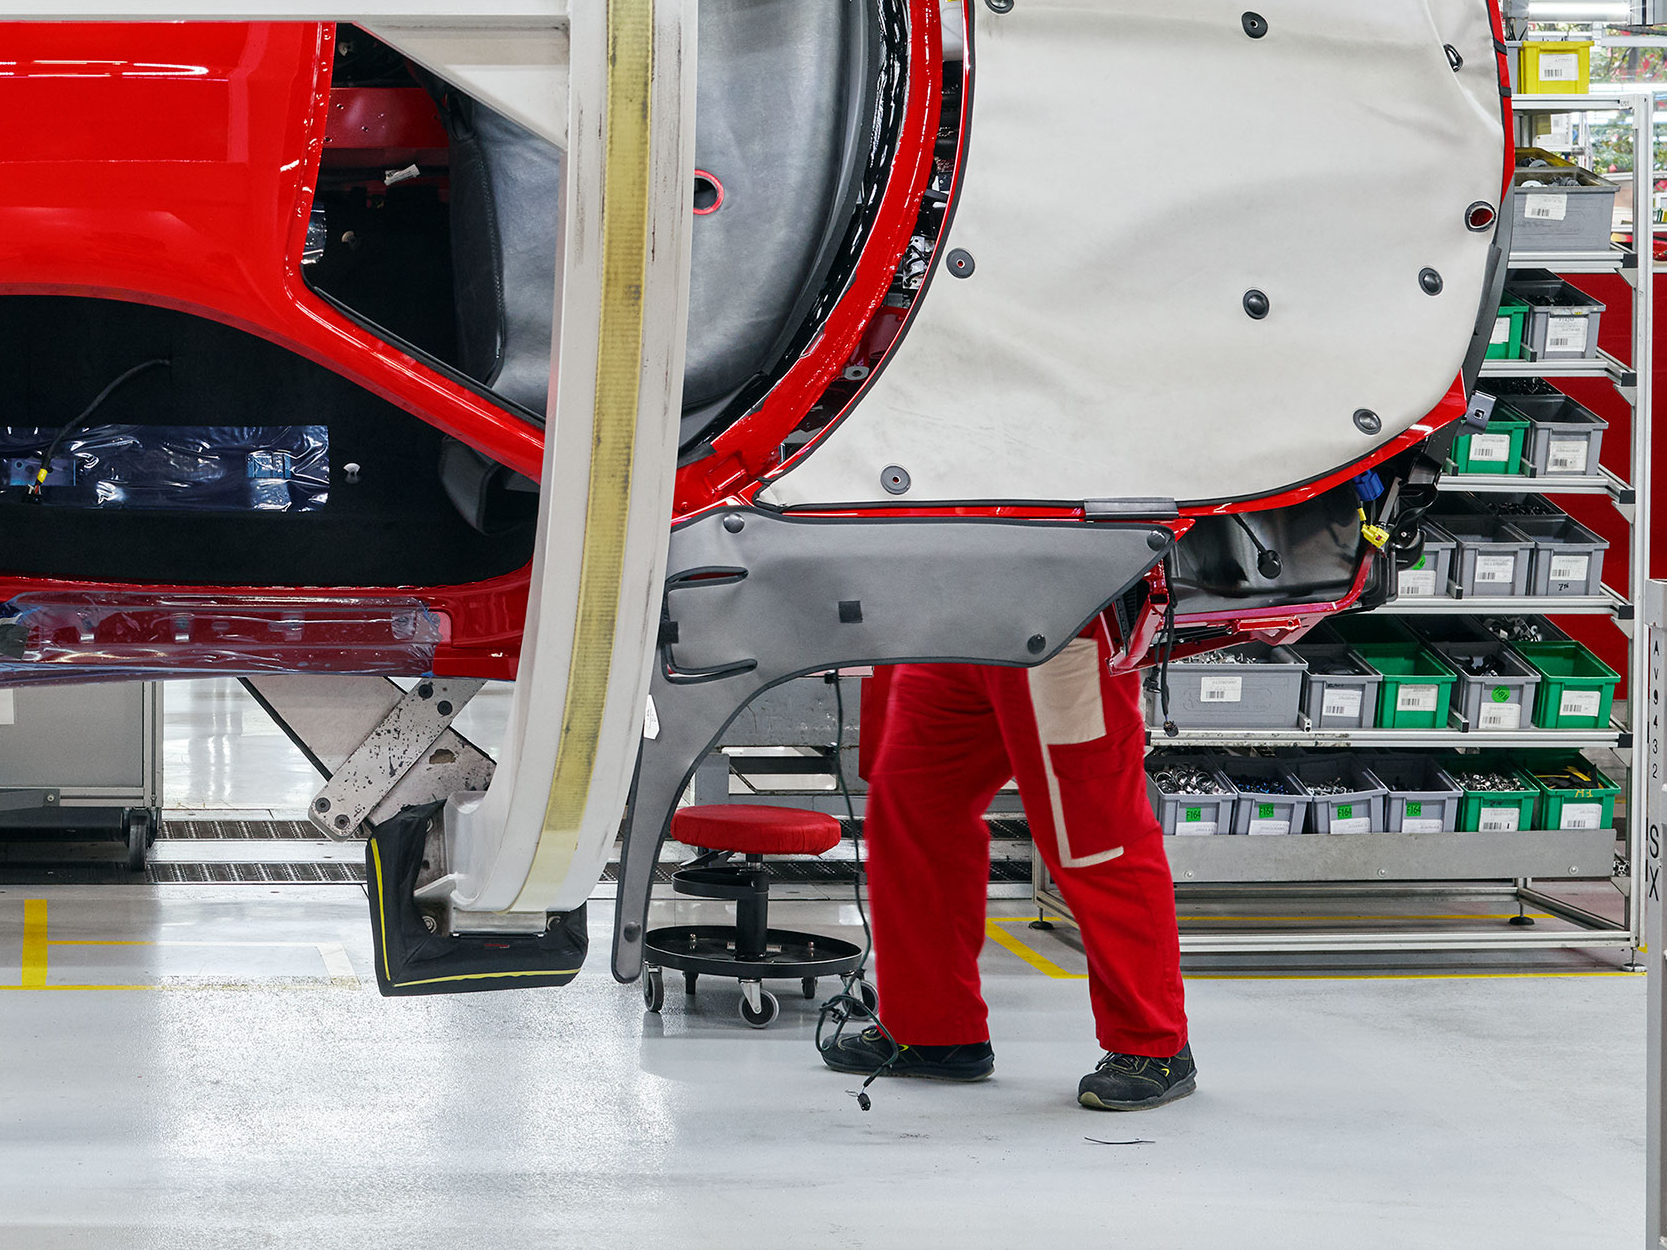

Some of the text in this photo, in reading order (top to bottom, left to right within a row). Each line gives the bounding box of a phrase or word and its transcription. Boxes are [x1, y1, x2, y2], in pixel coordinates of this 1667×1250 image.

[1259, 807, 1274, 816] F164
[1338, 808, 1352, 817] F164
[1406, 805, 1421, 814] F164
[1186, 810, 1201, 820] F164
